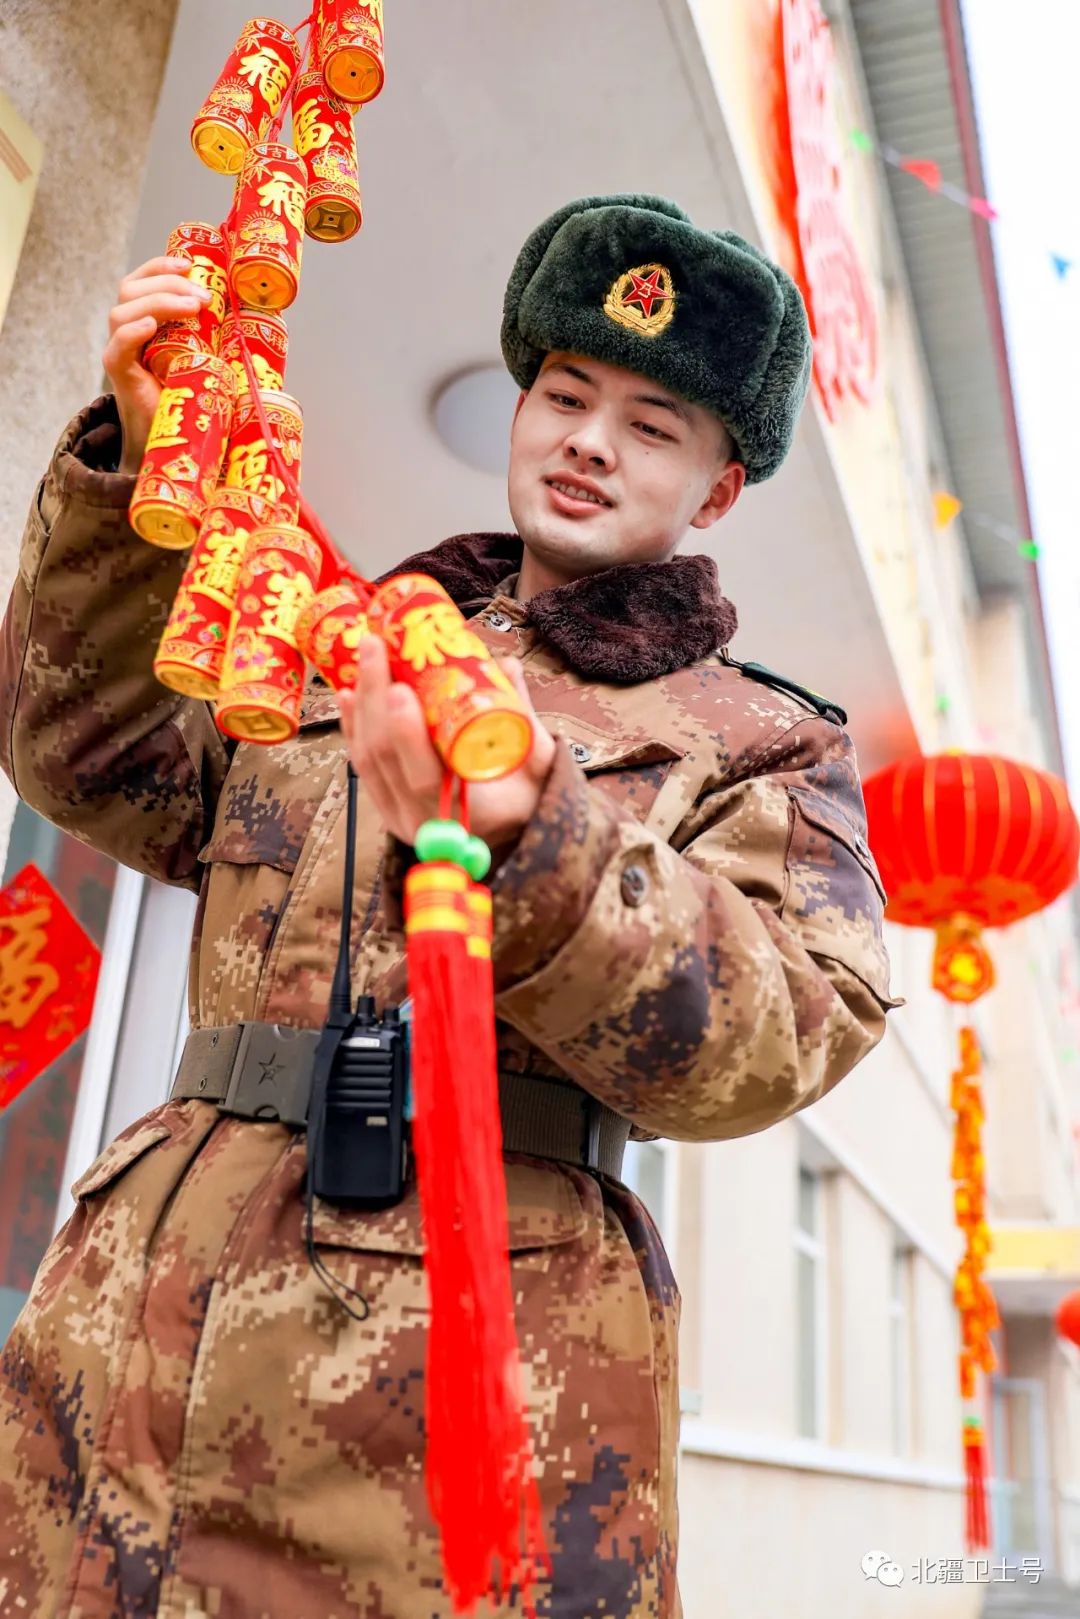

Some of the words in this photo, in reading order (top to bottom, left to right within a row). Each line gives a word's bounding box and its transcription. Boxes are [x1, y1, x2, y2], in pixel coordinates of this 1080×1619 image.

[268, 25, 279, 36] 吉
[236, 46, 292, 118] 福
[272, 146, 283, 159] 吉
[256, 171, 305, 243] 福
[194, 229, 206, 242] 吉
